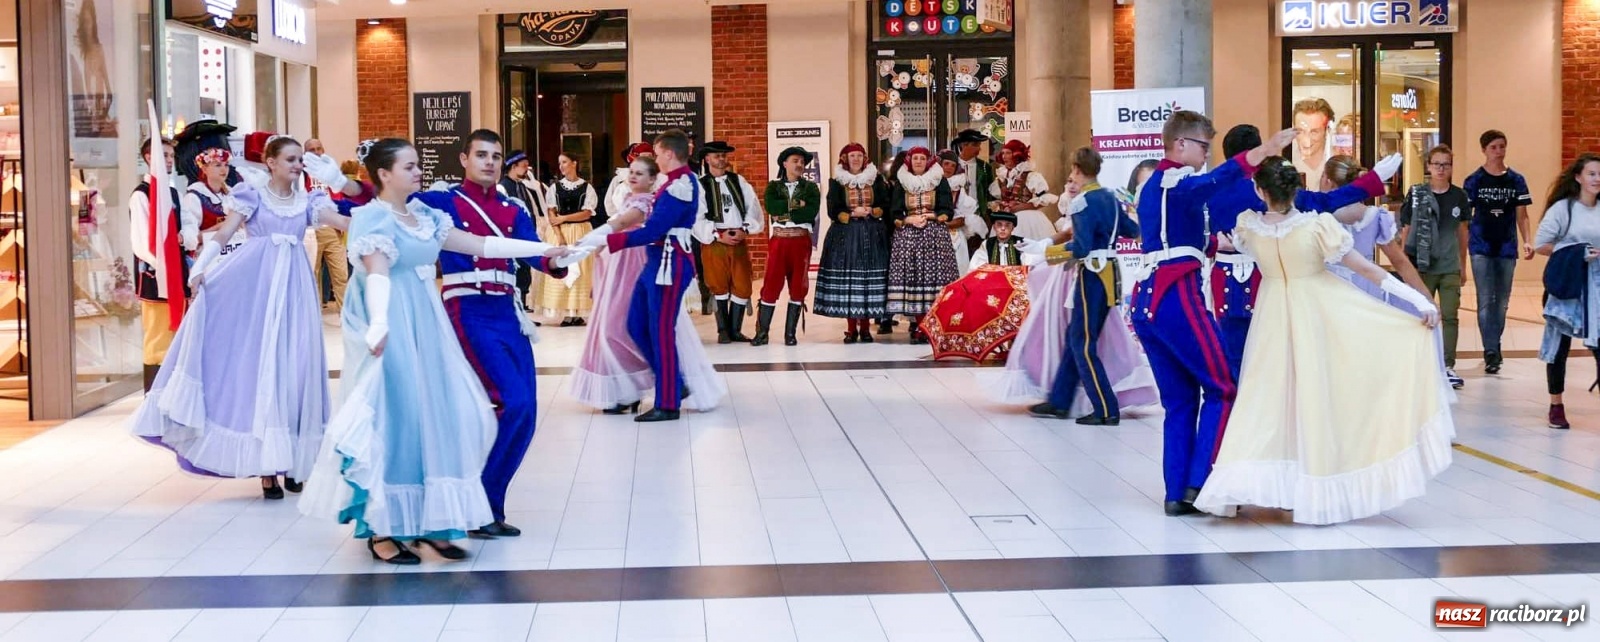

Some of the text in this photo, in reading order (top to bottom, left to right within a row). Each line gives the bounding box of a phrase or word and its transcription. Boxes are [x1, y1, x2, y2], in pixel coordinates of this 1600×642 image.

[1320, 2, 1411, 27] KLIER
[550, 23, 581, 41] OPAVA
[890, 19, 996, 32] KOUTE
[422, 95, 462, 109] NEJLEPŠÍ
[426, 108, 458, 120] BURGERY
[427, 121, 433, 131] V
[1099, 136, 1152, 148] KREATIVNÍ
